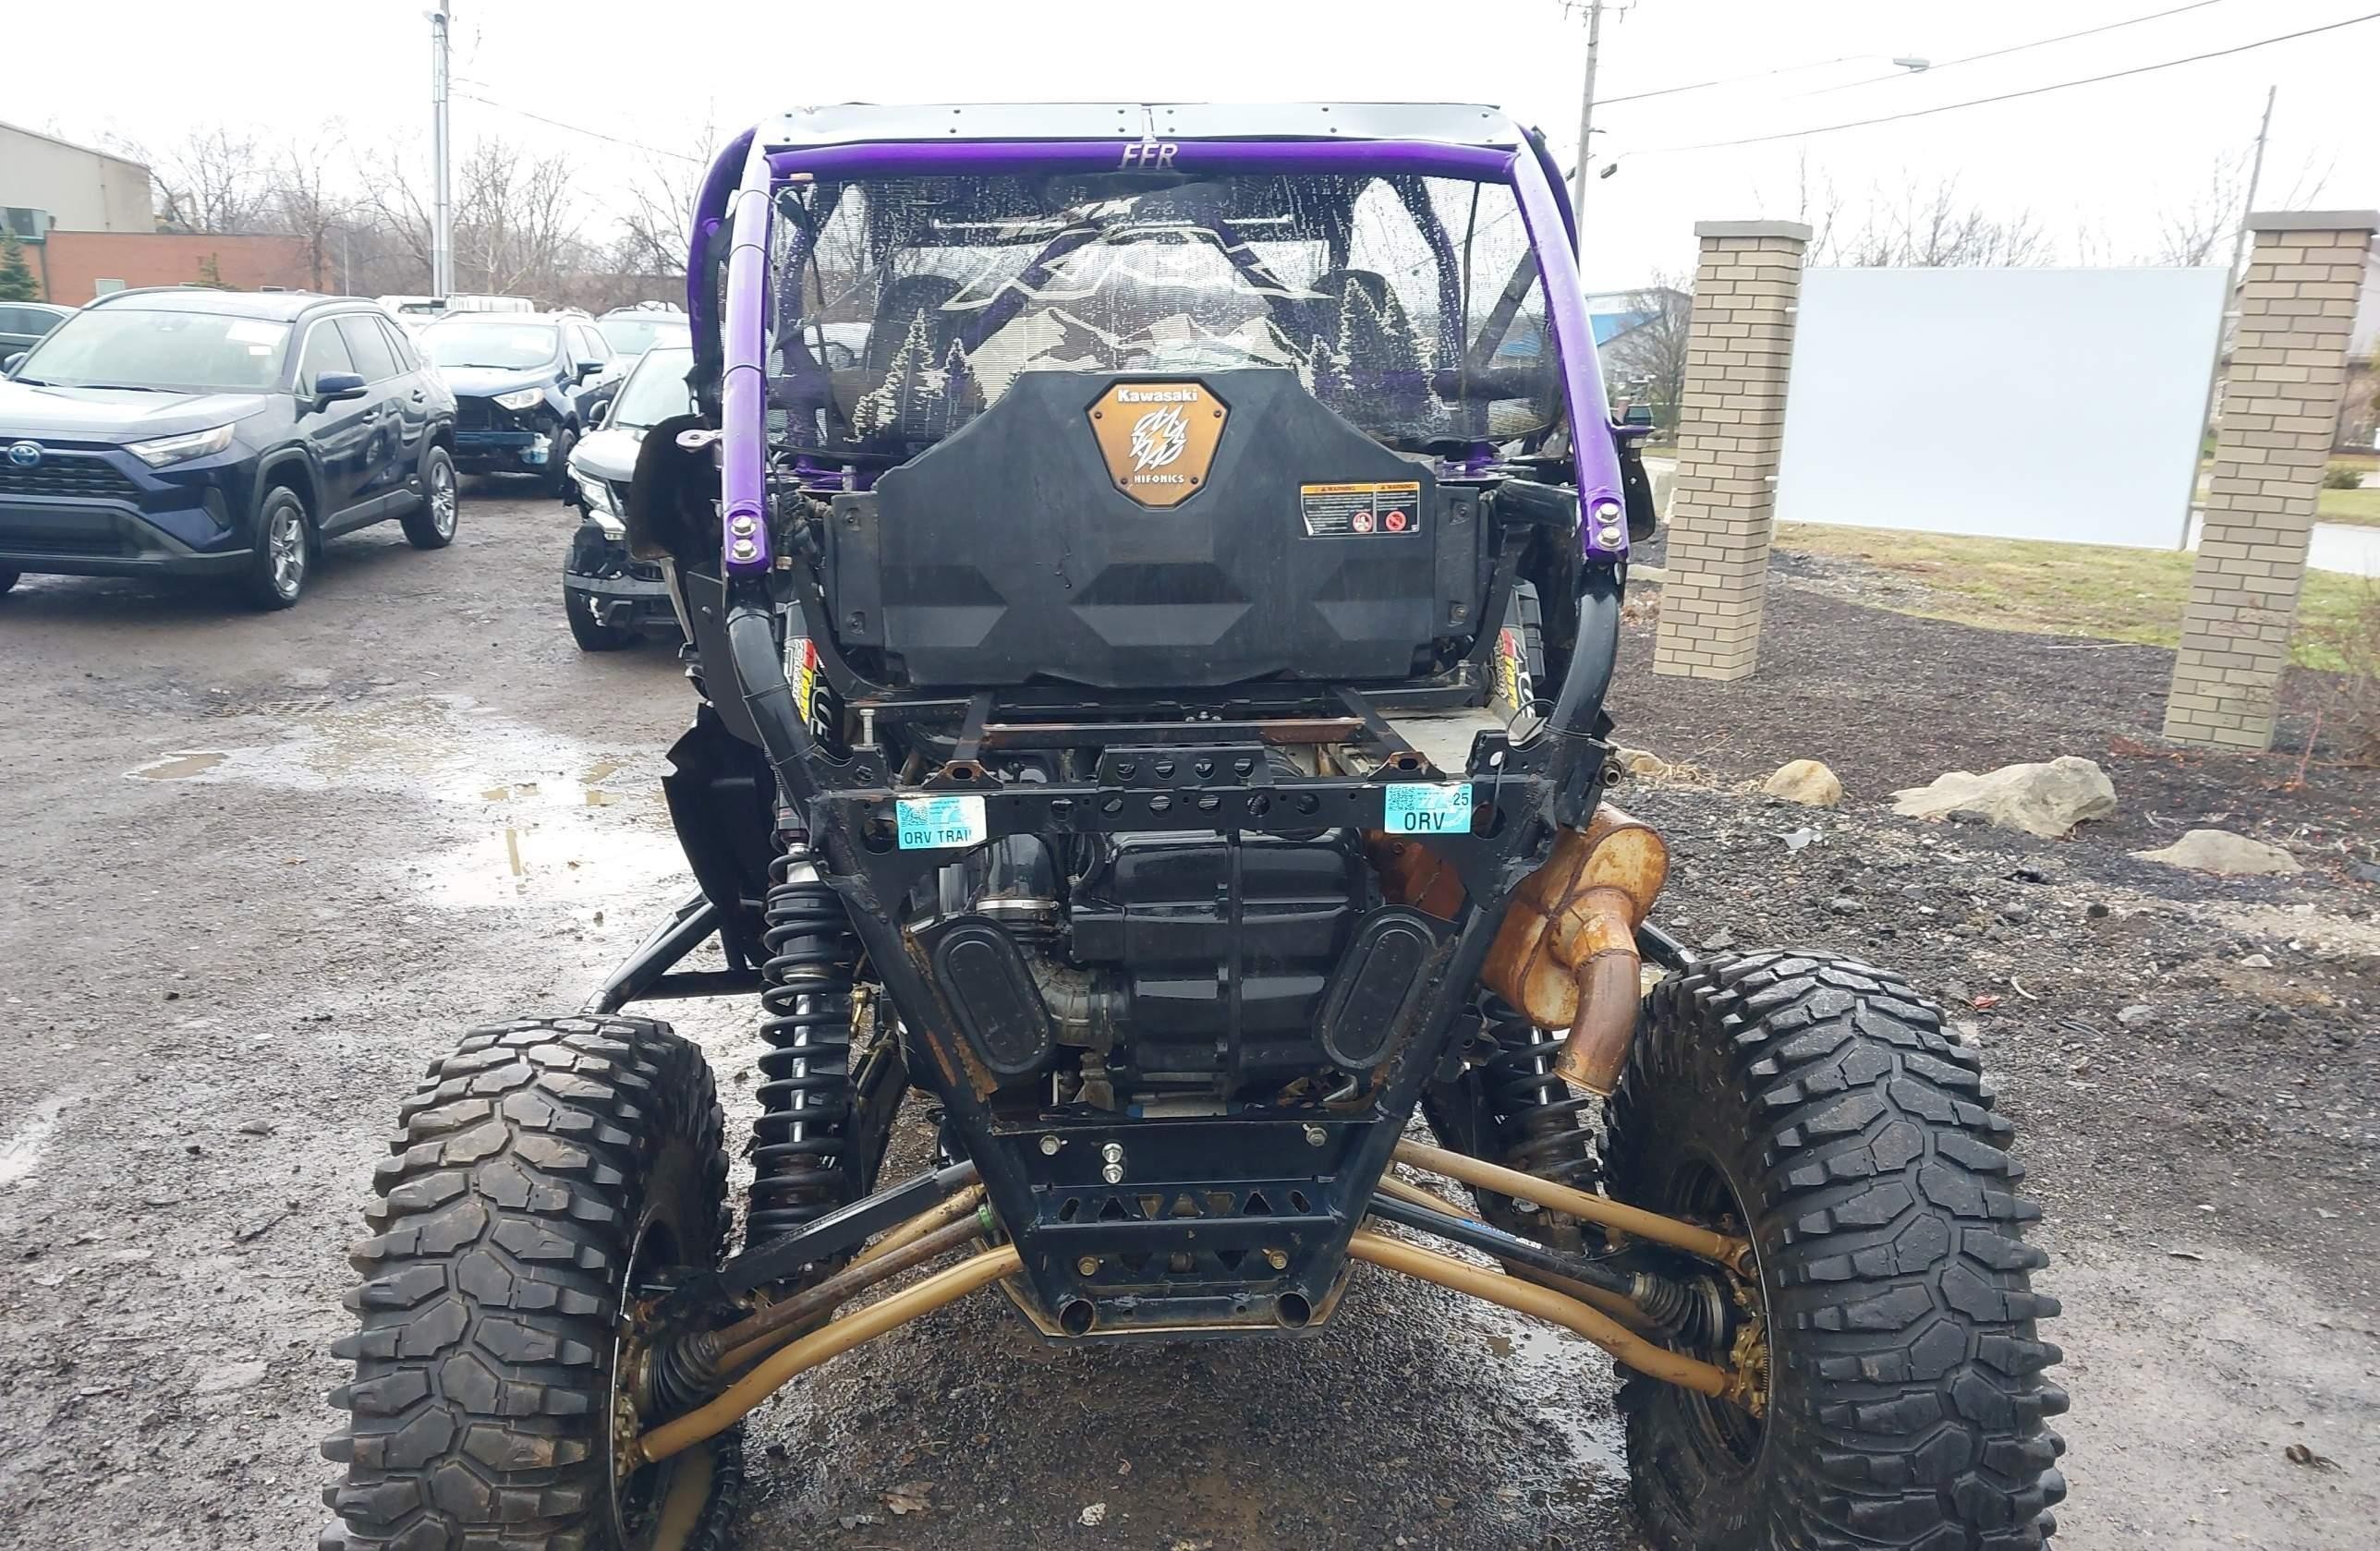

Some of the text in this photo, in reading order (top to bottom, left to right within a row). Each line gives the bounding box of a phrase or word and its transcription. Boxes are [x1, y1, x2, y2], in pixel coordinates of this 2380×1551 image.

[1118, 143, 1179, 170] FFR
[1118, 389, 1198, 403] Kawasaki
[1134, 474, 1184, 483] HIFONICS
[1452, 793, 1469, 806] 25
[1404, 812, 1445, 830] ORV
[905, 831, 931, 844] ORV
